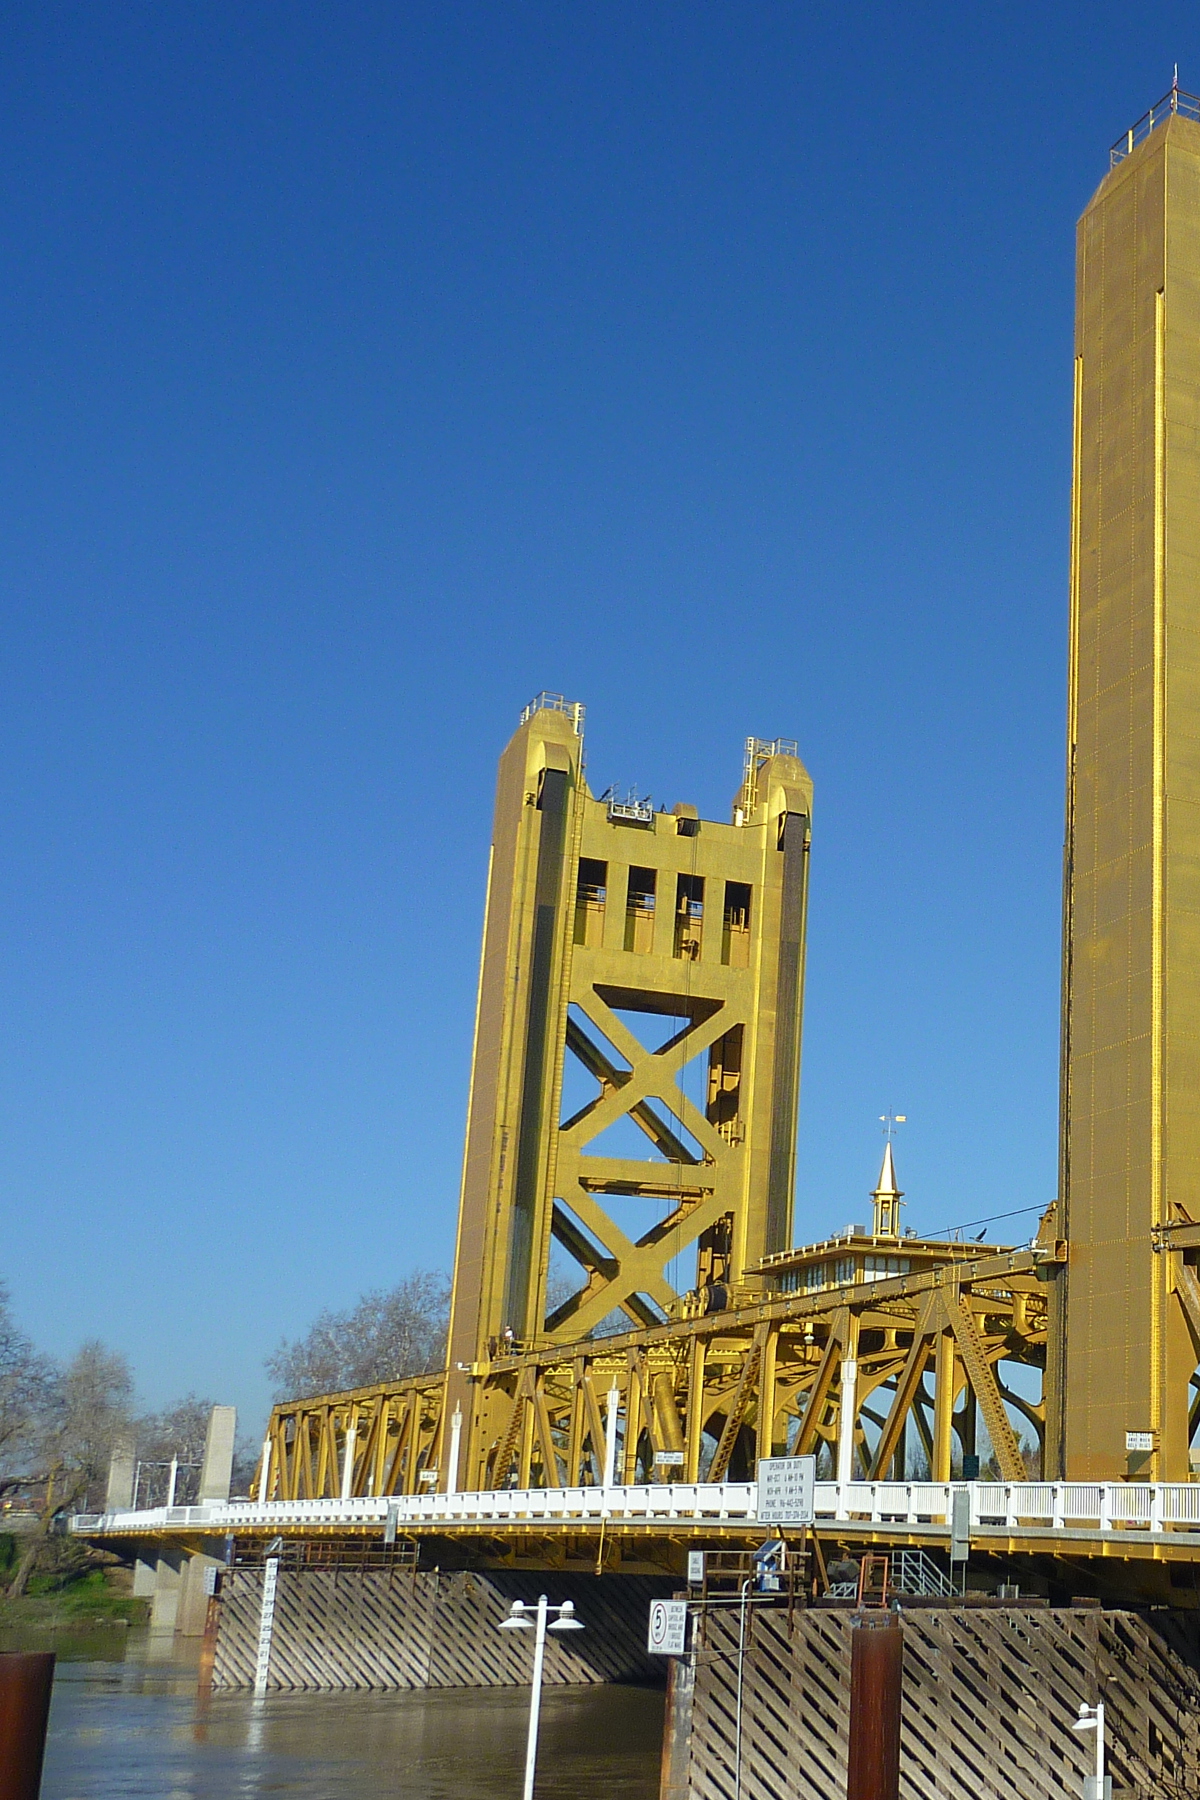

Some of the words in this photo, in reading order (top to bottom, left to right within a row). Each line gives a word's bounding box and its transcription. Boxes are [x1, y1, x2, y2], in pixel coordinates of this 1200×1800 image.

[769, 1462, 786, 1471] OPERATOR
[787, 1461, 792, 1469] ON
[794, 1460, 803, 1469] DUTY
[765, 1499, 777, 1508] PHONE
[761, 1511, 771, 1520] AFTER
[772, 1511, 783, 1520] HOURS
[656, 1609, 662, 1630] 5
